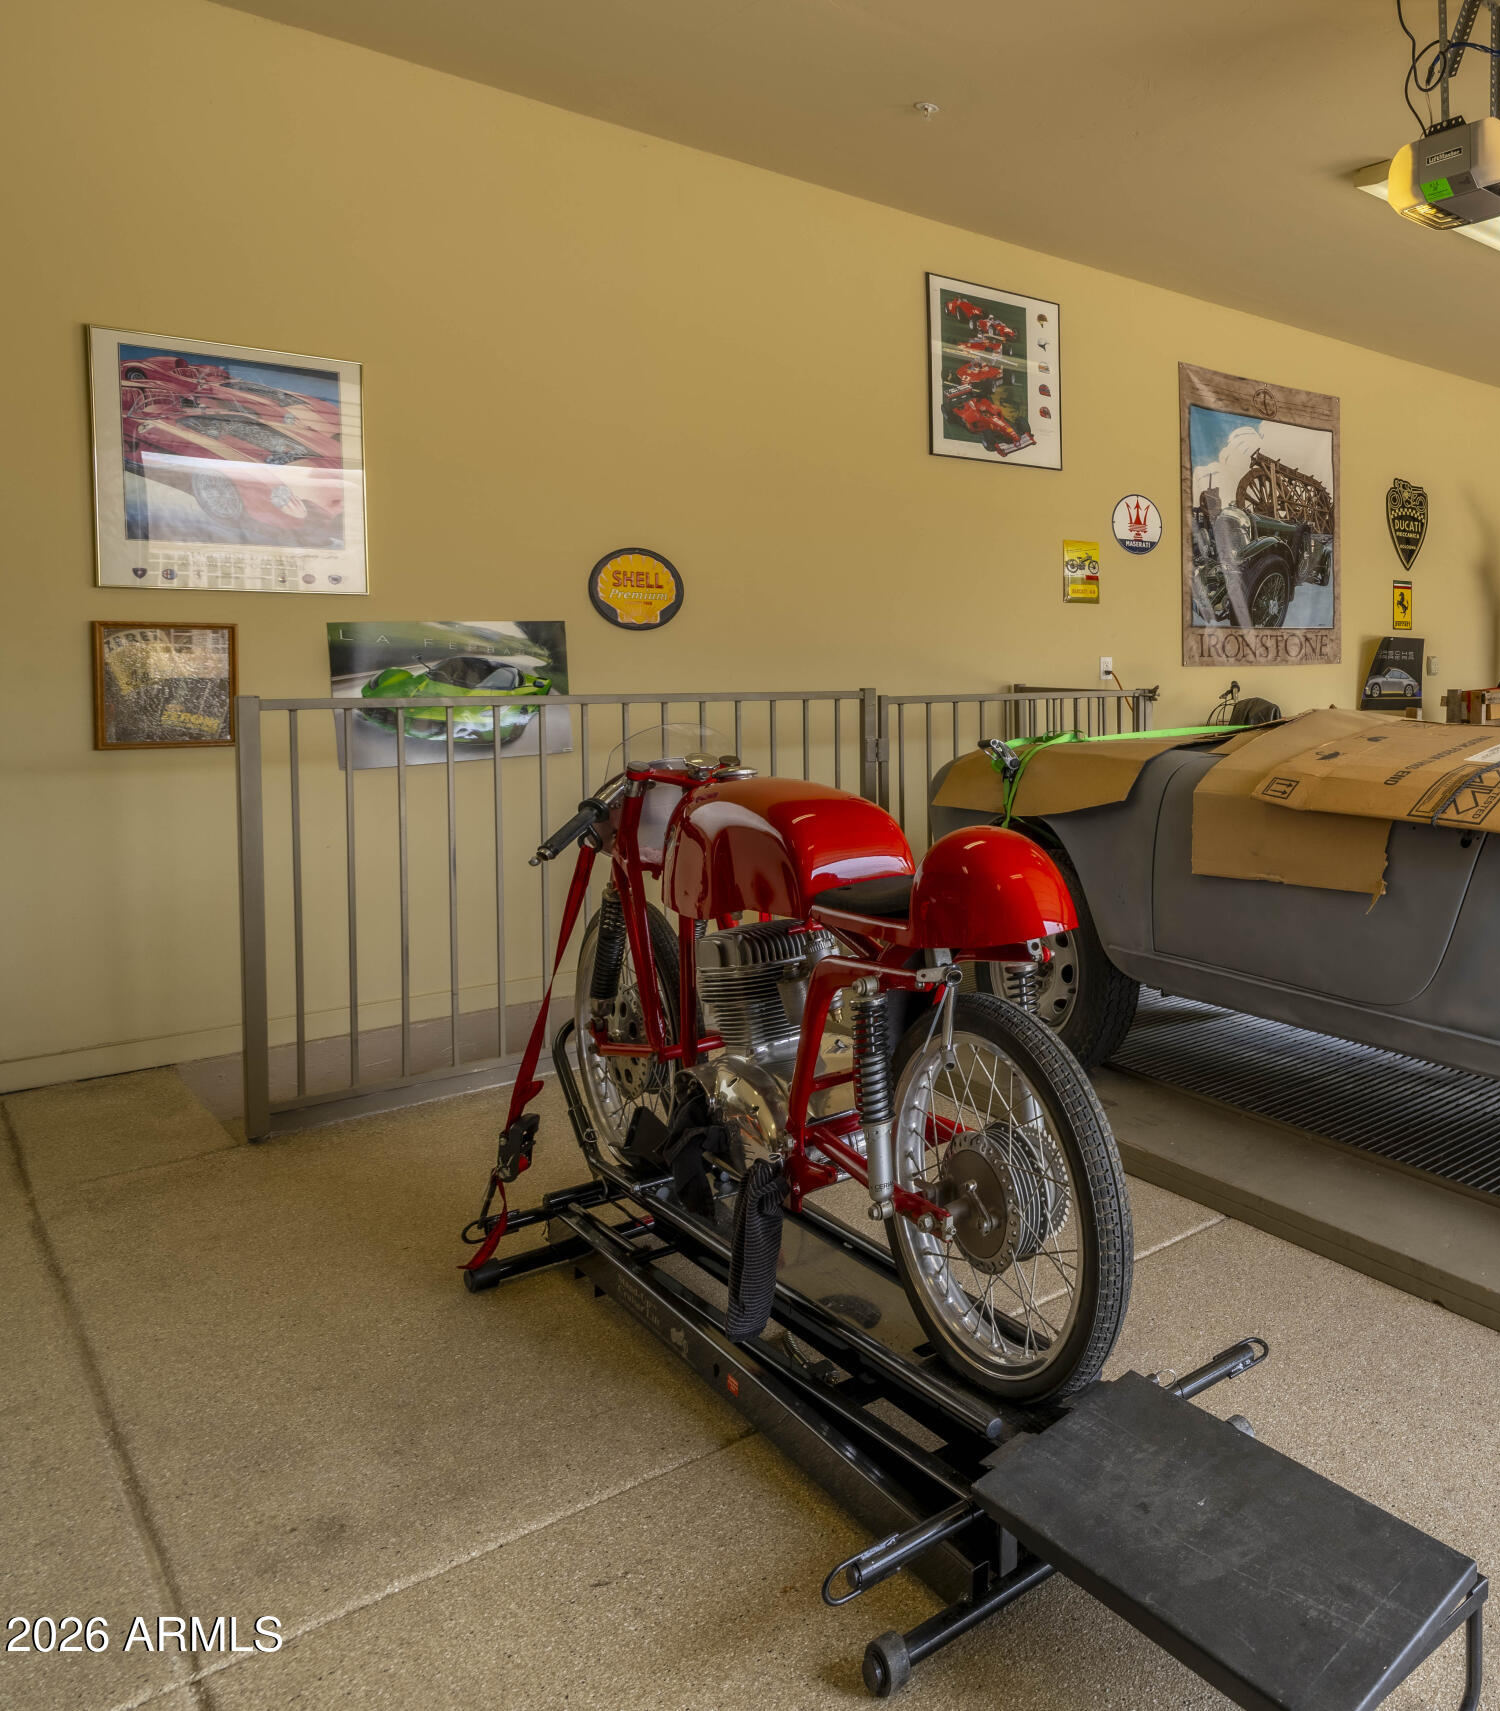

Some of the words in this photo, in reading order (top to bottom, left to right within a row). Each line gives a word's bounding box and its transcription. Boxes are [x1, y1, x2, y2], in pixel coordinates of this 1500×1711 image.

[1395, 519, 1421, 532] DUCATI
[1126, 540, 1151, 548] MASERATI
[612, 570, 664, 589] SHELL
[609, 588, 668, 601] Premium
[1199, 632, 1329, 658] IRONSTONE
[1383, 770, 1411, 786] END
[1471, 791, 1500, 819] TESTED
